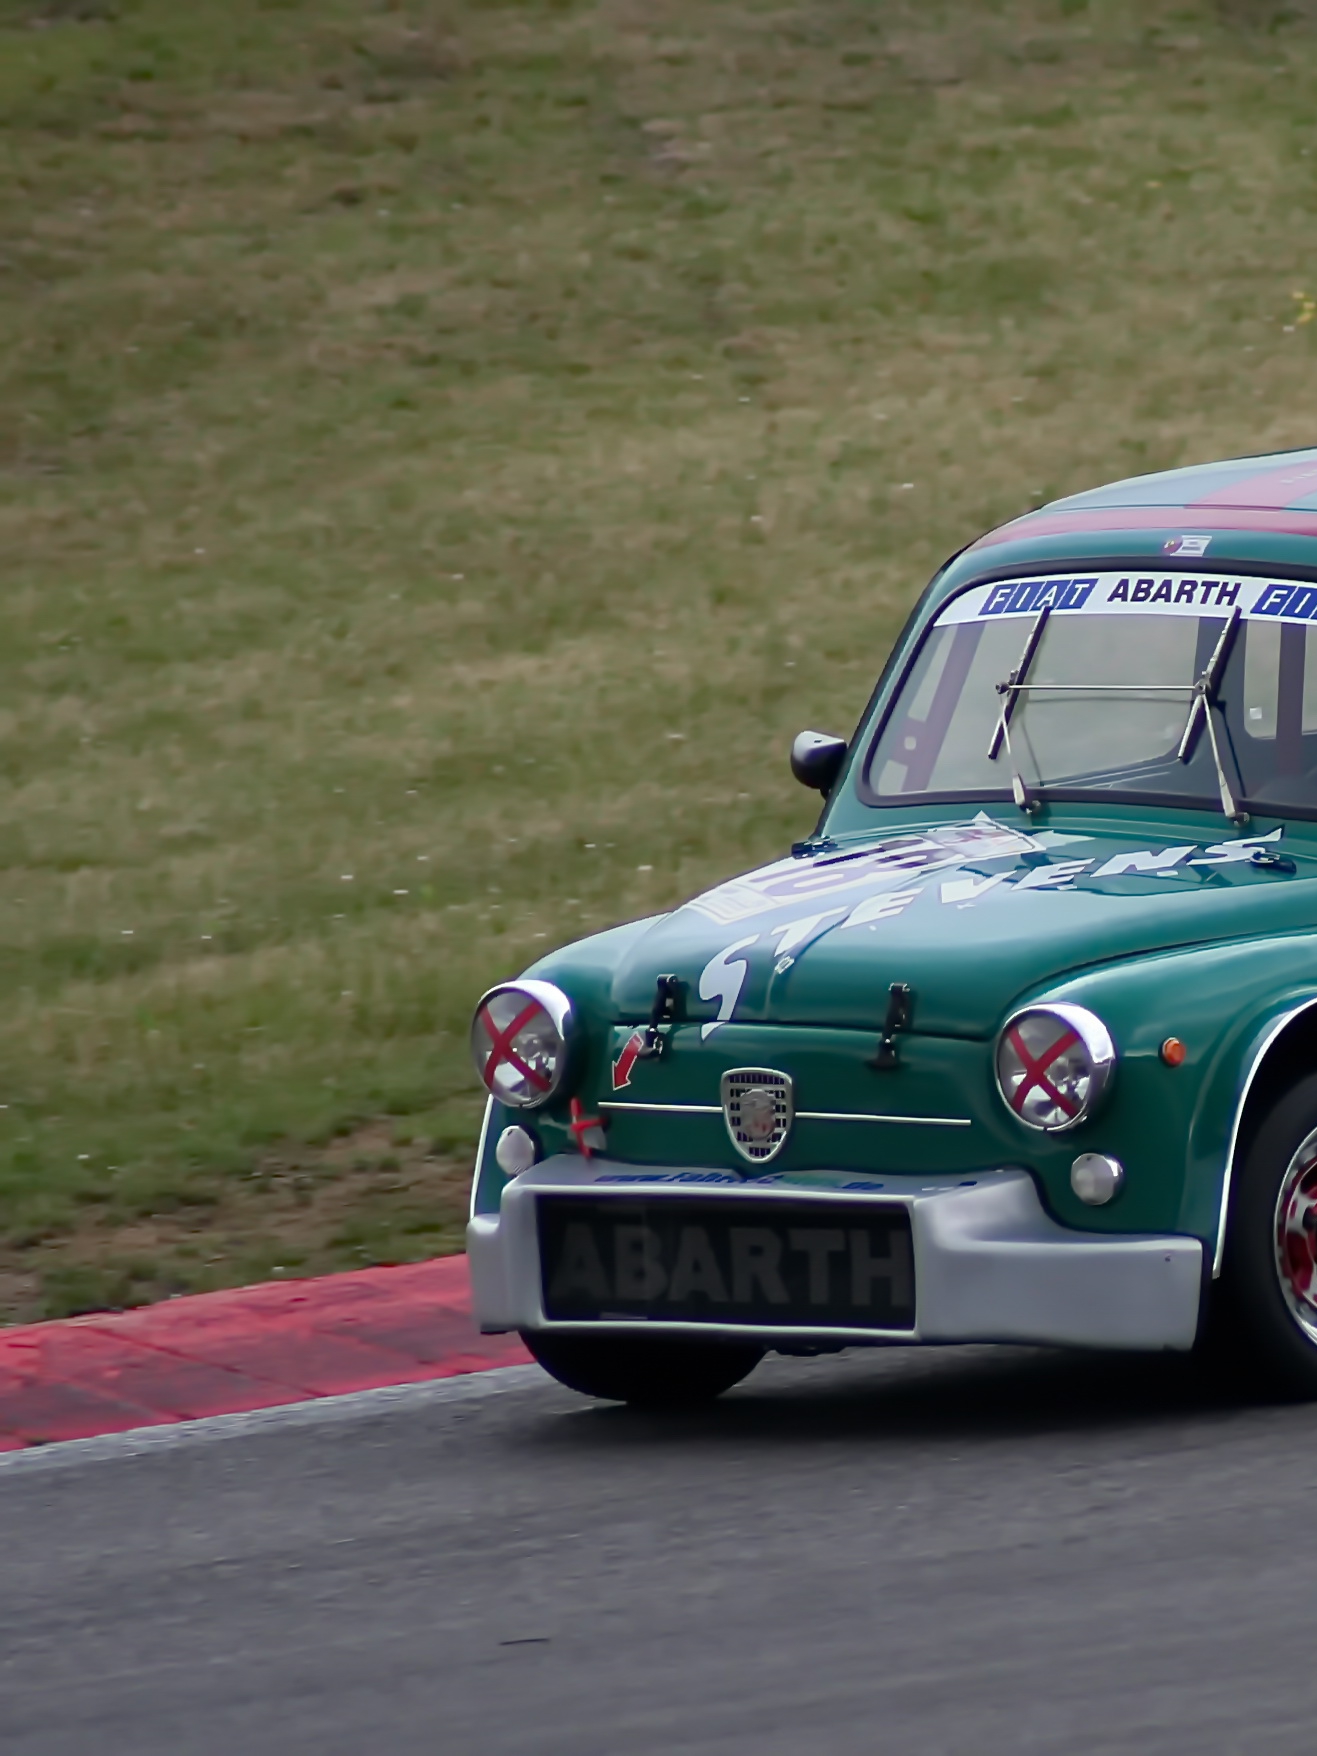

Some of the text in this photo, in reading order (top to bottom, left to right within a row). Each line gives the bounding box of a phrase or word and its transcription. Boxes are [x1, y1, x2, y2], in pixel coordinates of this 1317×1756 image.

[986, 581, 1095, 613] FIAT
[1107, 578, 1242, 607] ABARTH
[699, 824, 1285, 1042] STEVENS
[549, 1222, 912, 1306] ABARTH
